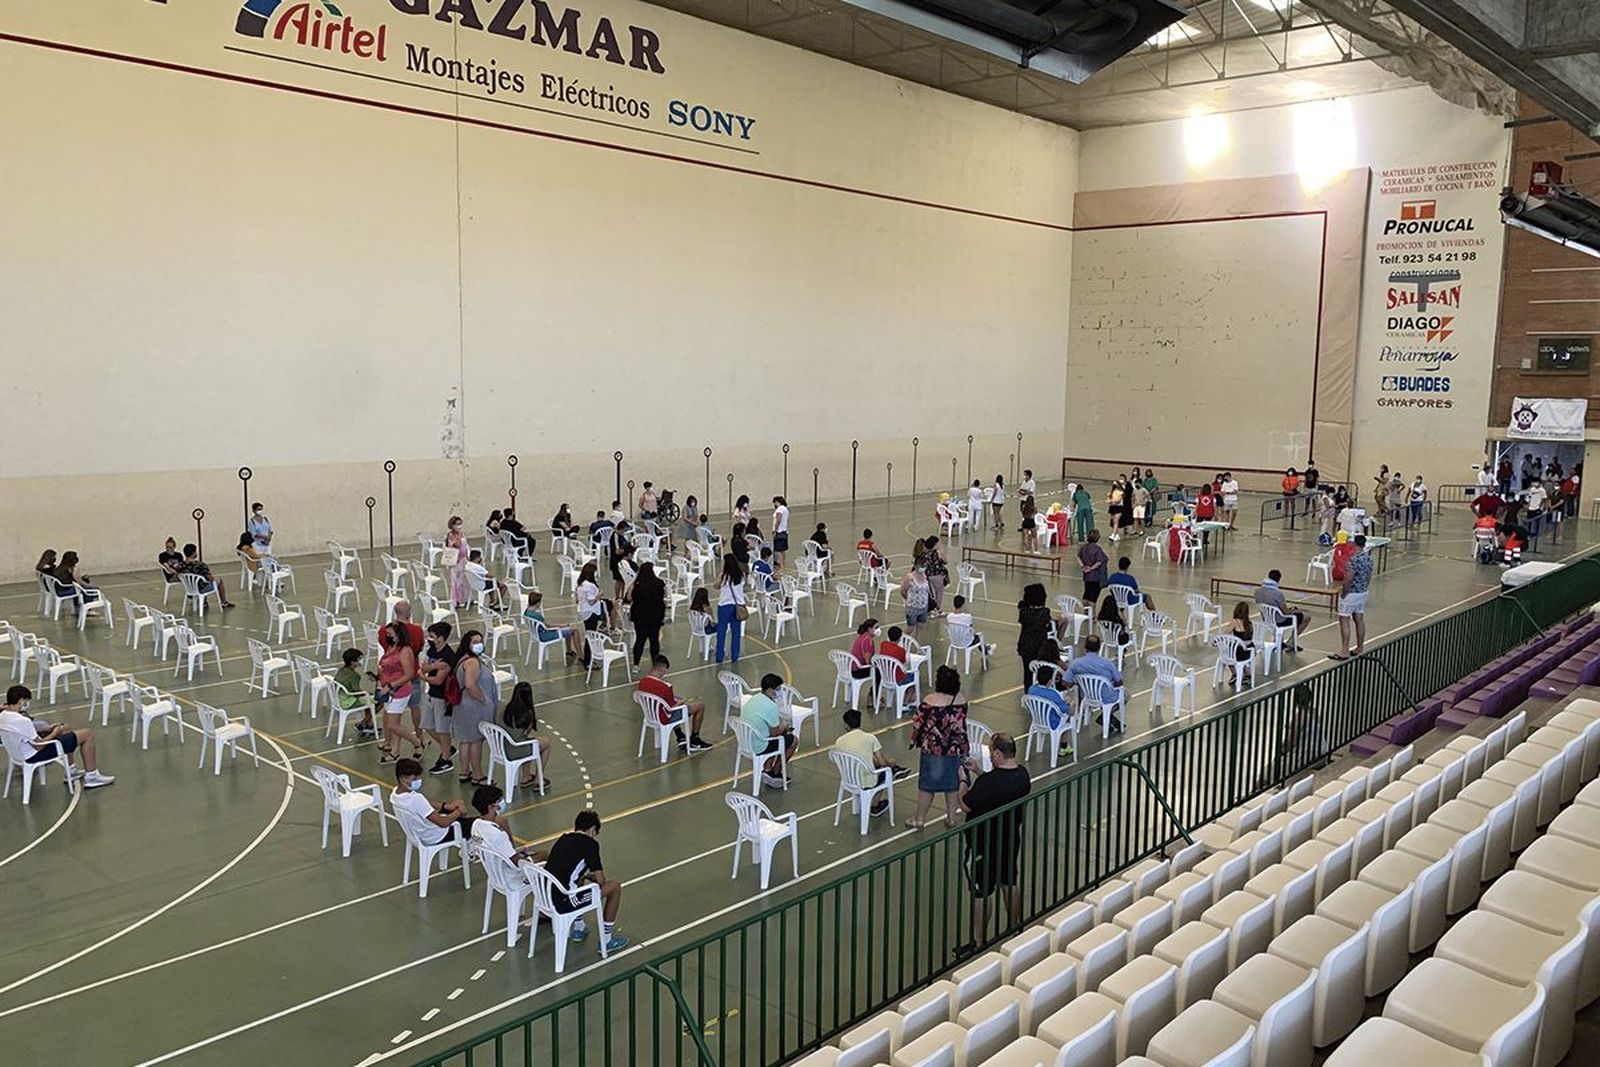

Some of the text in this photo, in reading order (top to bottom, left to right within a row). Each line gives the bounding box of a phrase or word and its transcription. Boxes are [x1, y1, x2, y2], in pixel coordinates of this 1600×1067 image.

[273, 3, 387, 62] Airtel
[405, 43, 651, 119] Montajes Eléctricos
[668, 100, 756, 140] SONY
[1382, 167, 1426, 177] MATERIALES
[1428, 166, 1437, 175] DE
[1436, 171, 1494, 182] SANEAMIENTOS
[1424, 184, 1433, 193] DE
[1435, 182, 1464, 191] COCINA
[1384, 218, 1474, 235] PRONUCAL
[1427, 240, 1438, 249] DE
[1441, 237, 1485, 248] VIVIENDAS
[1379, 251, 1477, 265] Telf. 923 54 21 98
[1390, 268, 1461, 279] construcciones
[1387, 316, 1441, 330] DIAGO
[1399, 376, 1451, 392] BUADES
[1377, 397, 1454, 409] GAYAFORES
